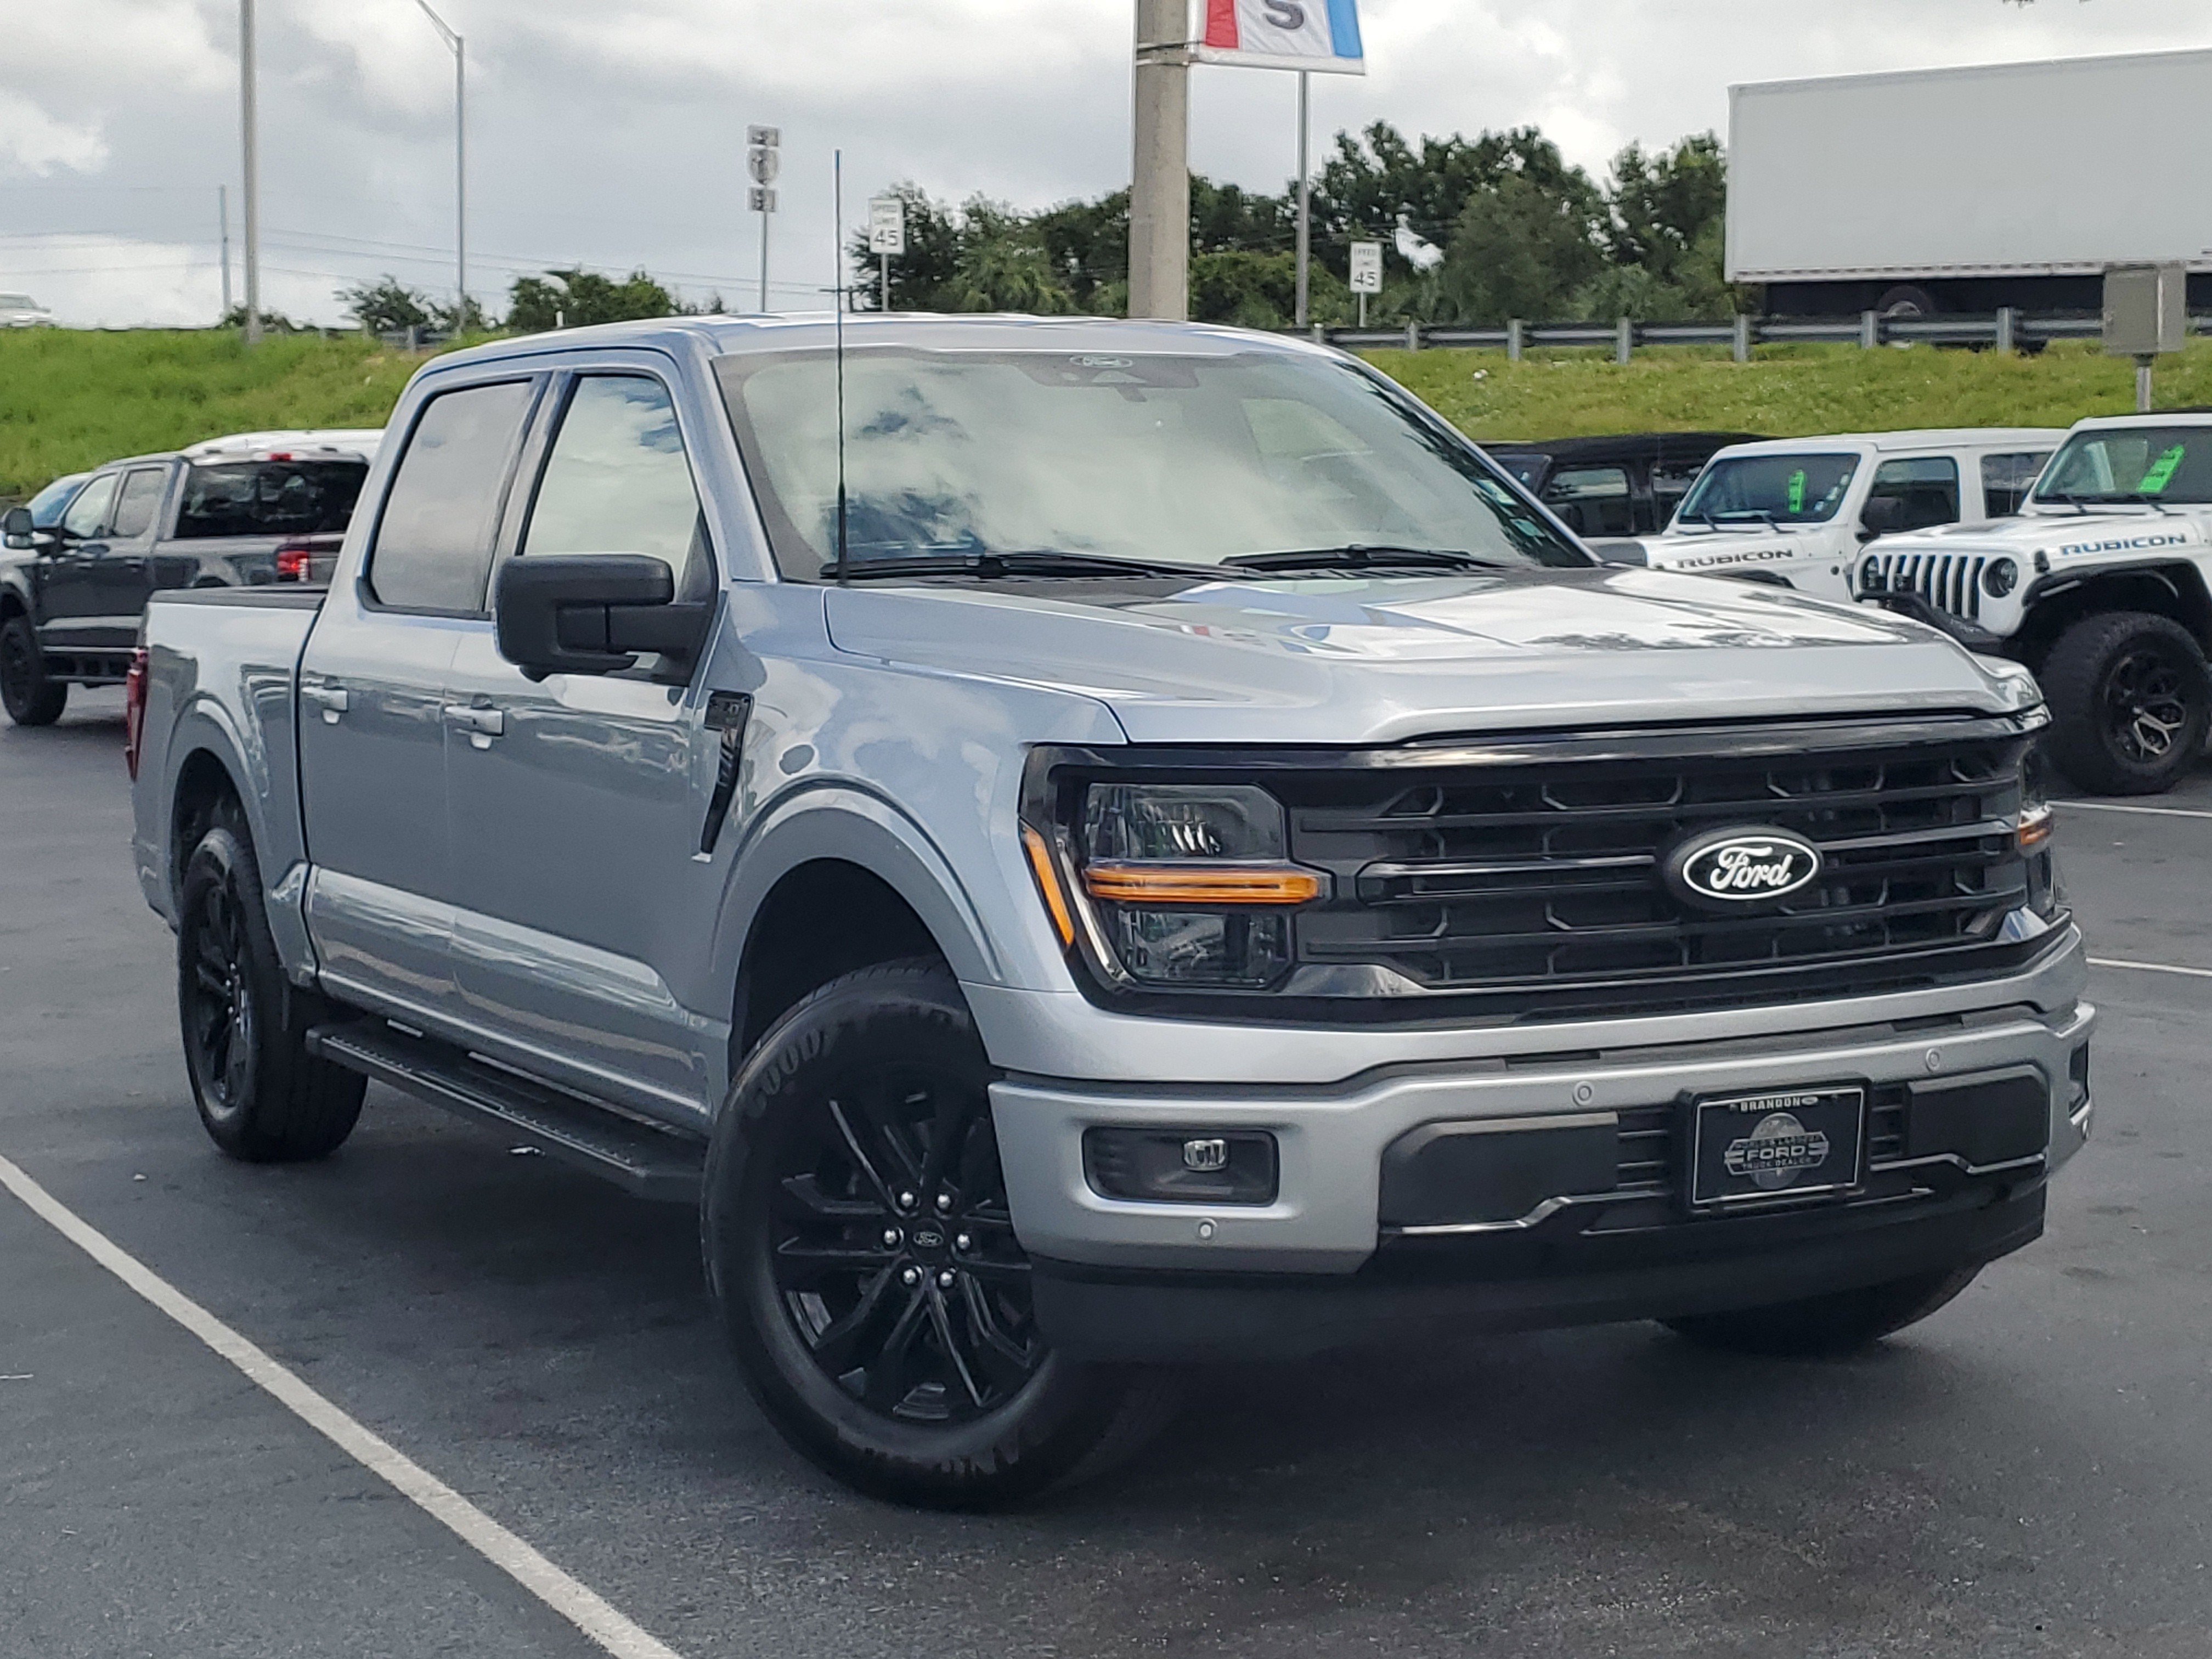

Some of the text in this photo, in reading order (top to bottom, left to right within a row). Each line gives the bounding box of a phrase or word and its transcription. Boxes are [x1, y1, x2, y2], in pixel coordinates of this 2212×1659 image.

[874, 229, 898, 246] 45
[1354, 271, 1375, 286] 45
[2059, 533, 2187, 555] RUBICON
[1677, 549, 1793, 568] RUBICON
[1710, 846, 1794, 890] Ford
[1740, 1097, 1801, 1111] BRANDON
[1747, 1145, 1806, 1161] FORD
